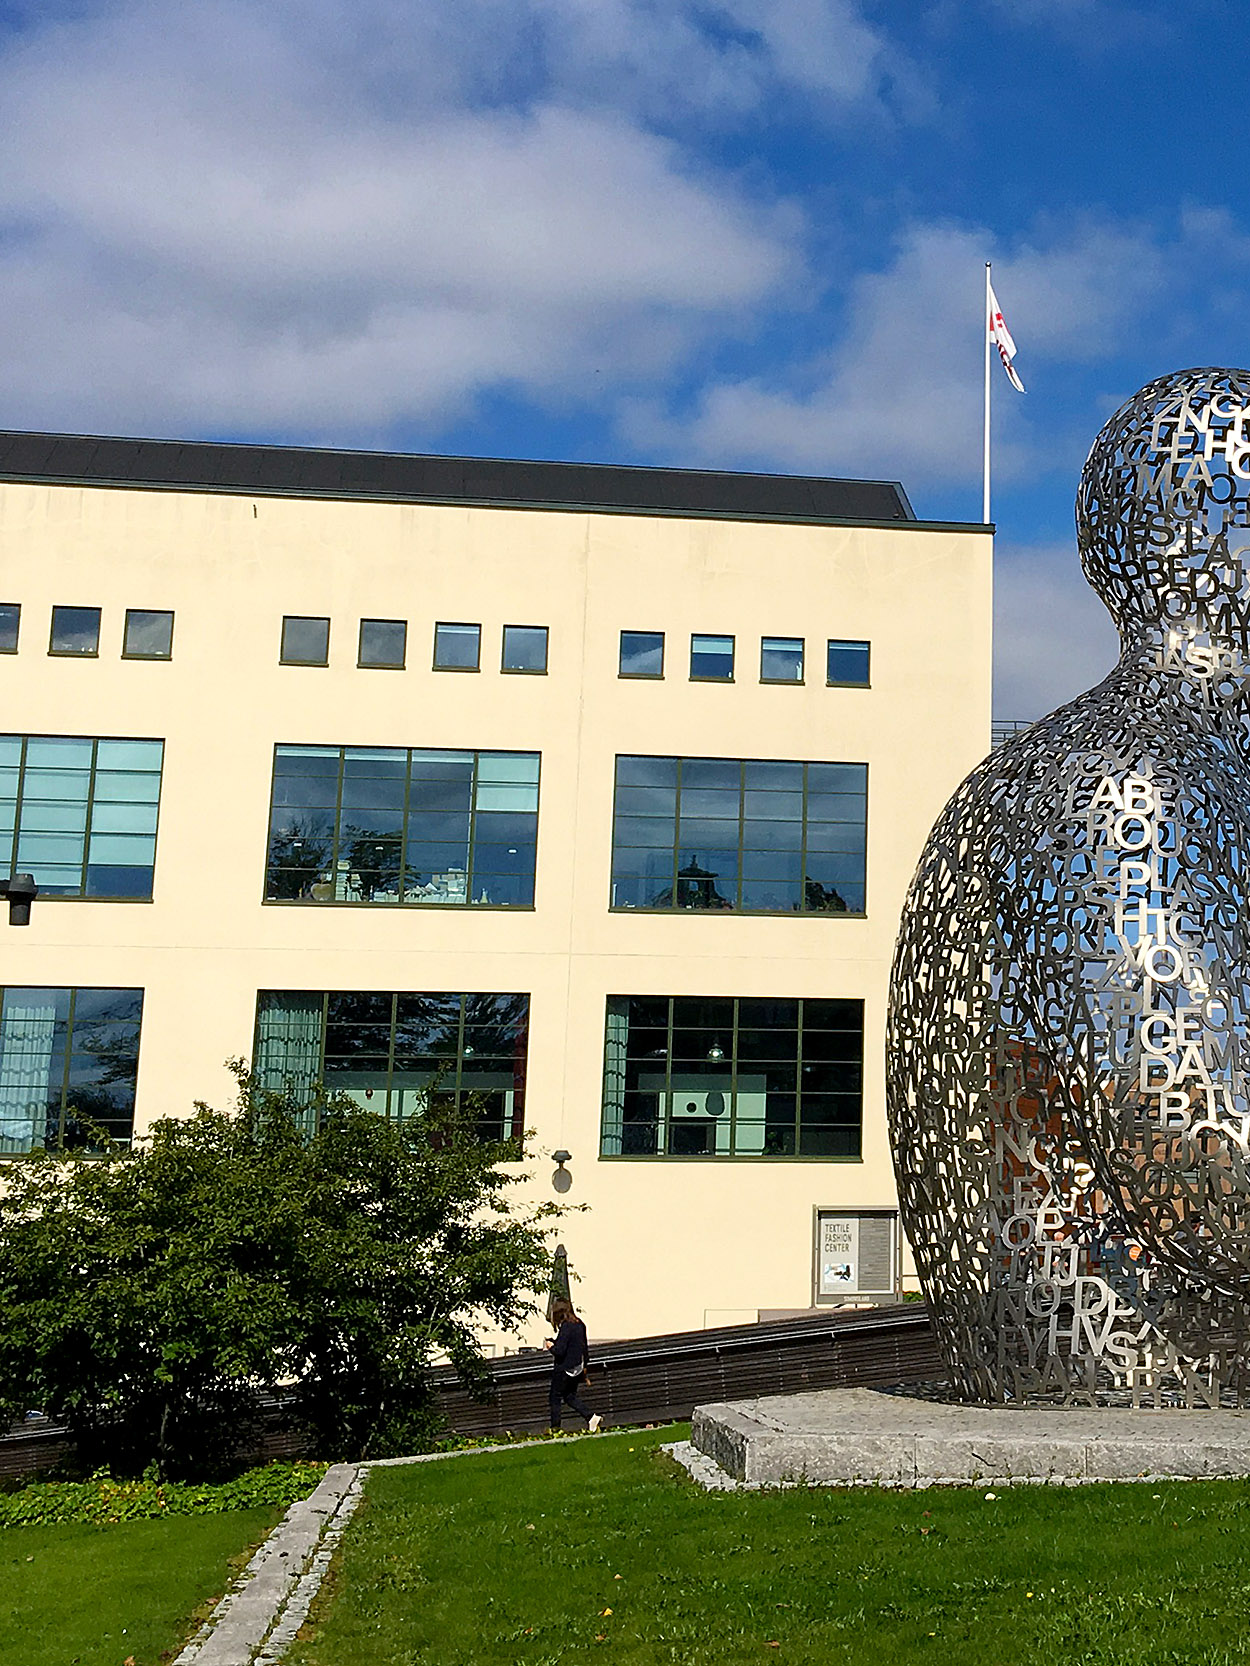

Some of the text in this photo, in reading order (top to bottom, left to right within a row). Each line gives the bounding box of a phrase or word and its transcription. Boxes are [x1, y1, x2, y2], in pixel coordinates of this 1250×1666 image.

[825, 1224, 850, 1233] TEXTILE
[825, 1233, 852, 1243] FASHION
[824, 1243, 850, 1253] CENTER
